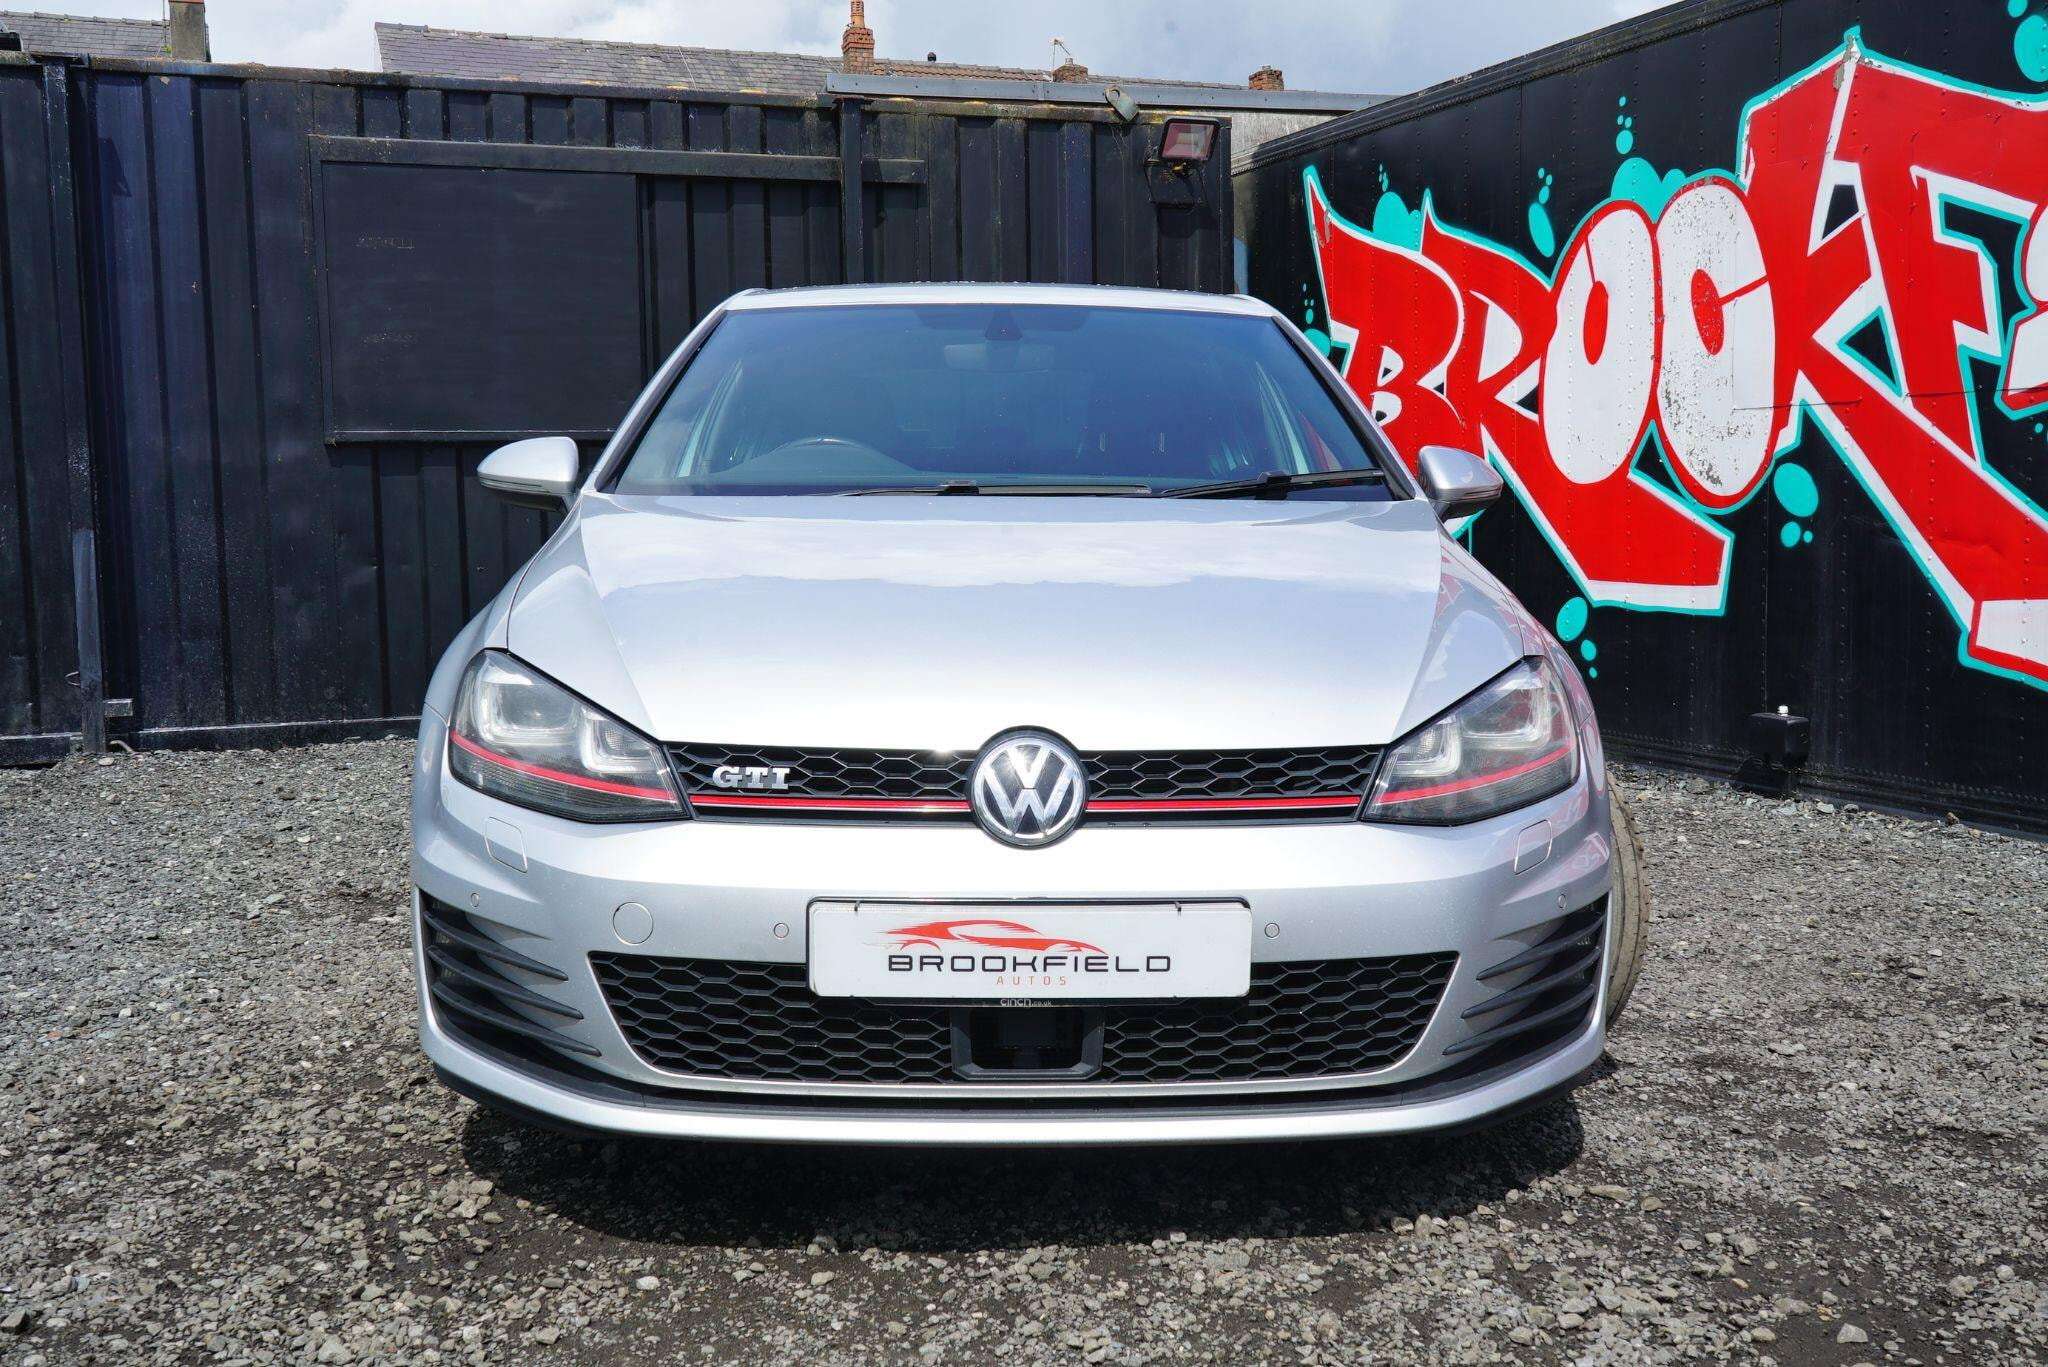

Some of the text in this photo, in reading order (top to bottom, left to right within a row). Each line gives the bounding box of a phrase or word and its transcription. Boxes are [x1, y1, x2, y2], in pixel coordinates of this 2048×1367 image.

[712, 765, 790, 790] GTI
[976, 736, 1078, 840] VW
[888, 955, 1171, 973] BROOKFIELD
[996, 975, 1067, 986] AUTOS
